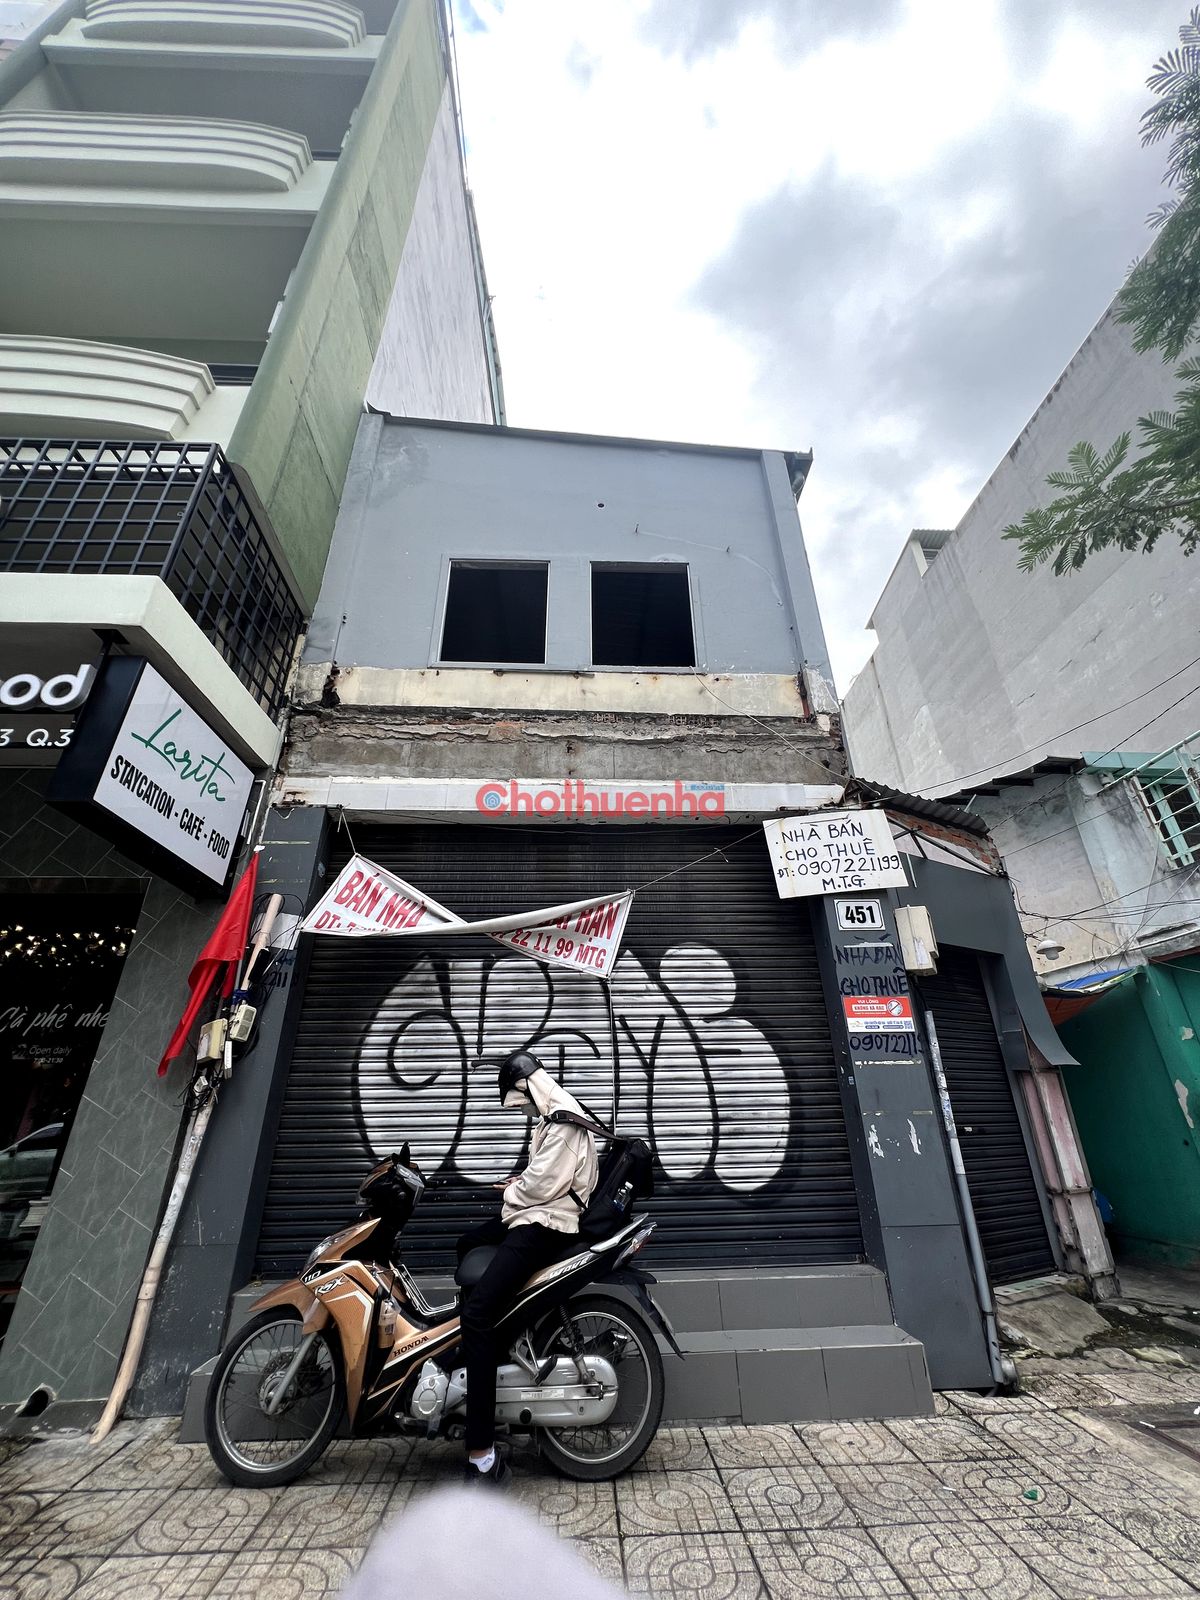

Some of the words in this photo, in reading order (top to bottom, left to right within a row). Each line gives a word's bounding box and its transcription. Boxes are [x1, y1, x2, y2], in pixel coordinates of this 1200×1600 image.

[26, 728, 75, 747] Q.3
[131, 708, 236, 802] Larita
[110, 754, 175, 820] STAYCATION
[179, 808, 205, 841] CAFÉ
[207, 829, 231, 859] FOOD
[781, 823, 821, 844] NHÀ
[827, 819, 864, 839] BÁN
[785, 847, 818, 861] CHO
[823, 837, 875, 857] THUÊ
[334, 870, 388, 918] BÁN
[375, 892, 427, 929] NHÀ
[845, 905, 876, 924] 451
[533, 932, 552, 954] 11
[554, 937, 574, 959] 99
[574, 943, 607, 969] MTG
[22, 1003, 73, 1037] phê
[393, 1335, 430, 1357] HONDA
